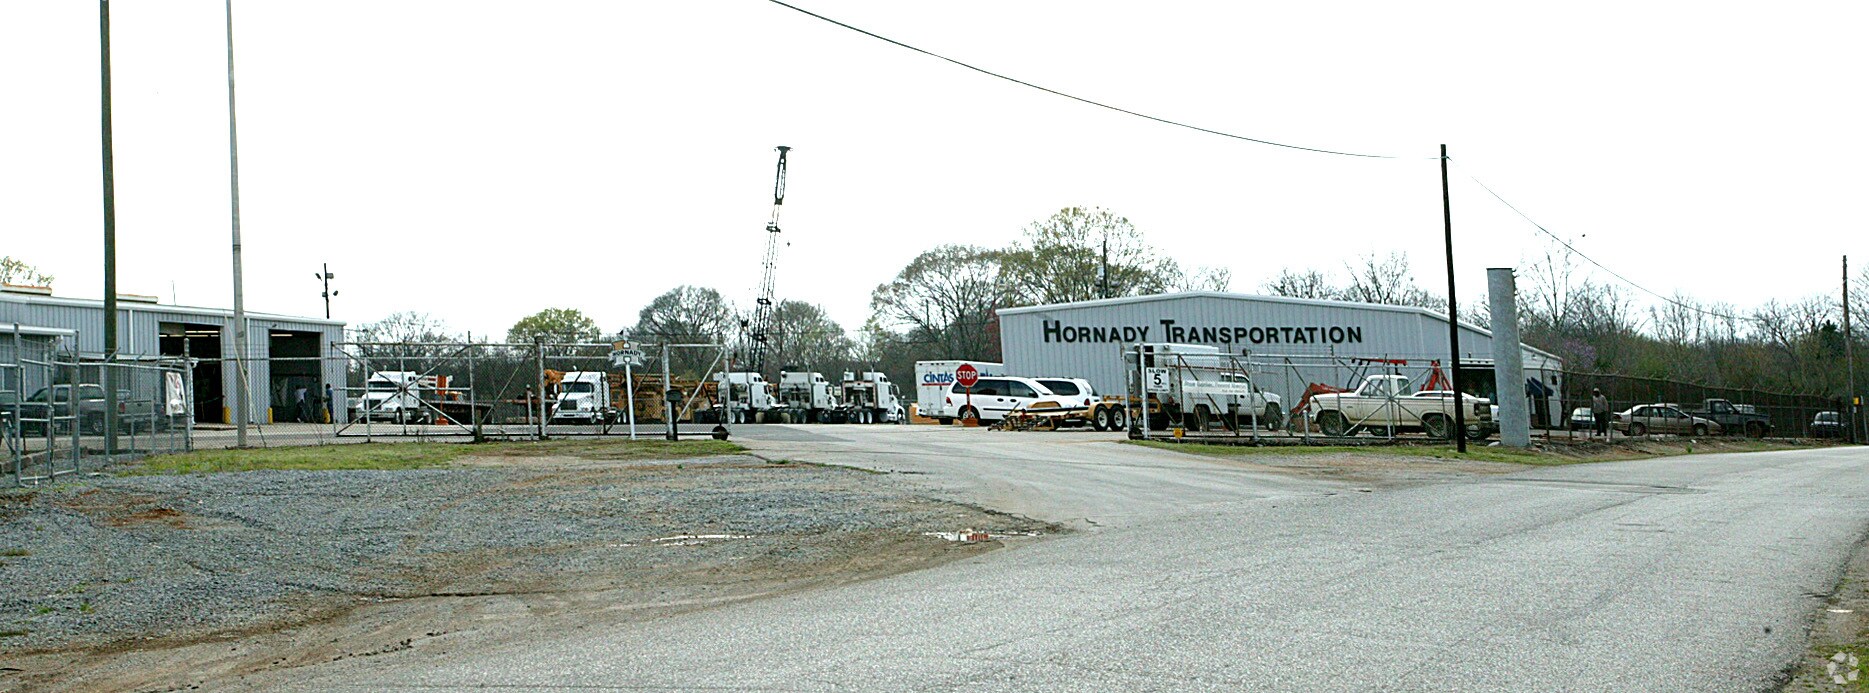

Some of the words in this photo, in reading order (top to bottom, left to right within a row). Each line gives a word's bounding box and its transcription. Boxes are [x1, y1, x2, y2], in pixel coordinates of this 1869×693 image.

[1042, 320, 1149, 344] HORNADY
[1159, 319, 1362, 344] TRANSPORTATION
[923, 370, 955, 383] CINTAS
[957, 370, 977, 380] STOP
[1153, 373, 1162, 386] 5
